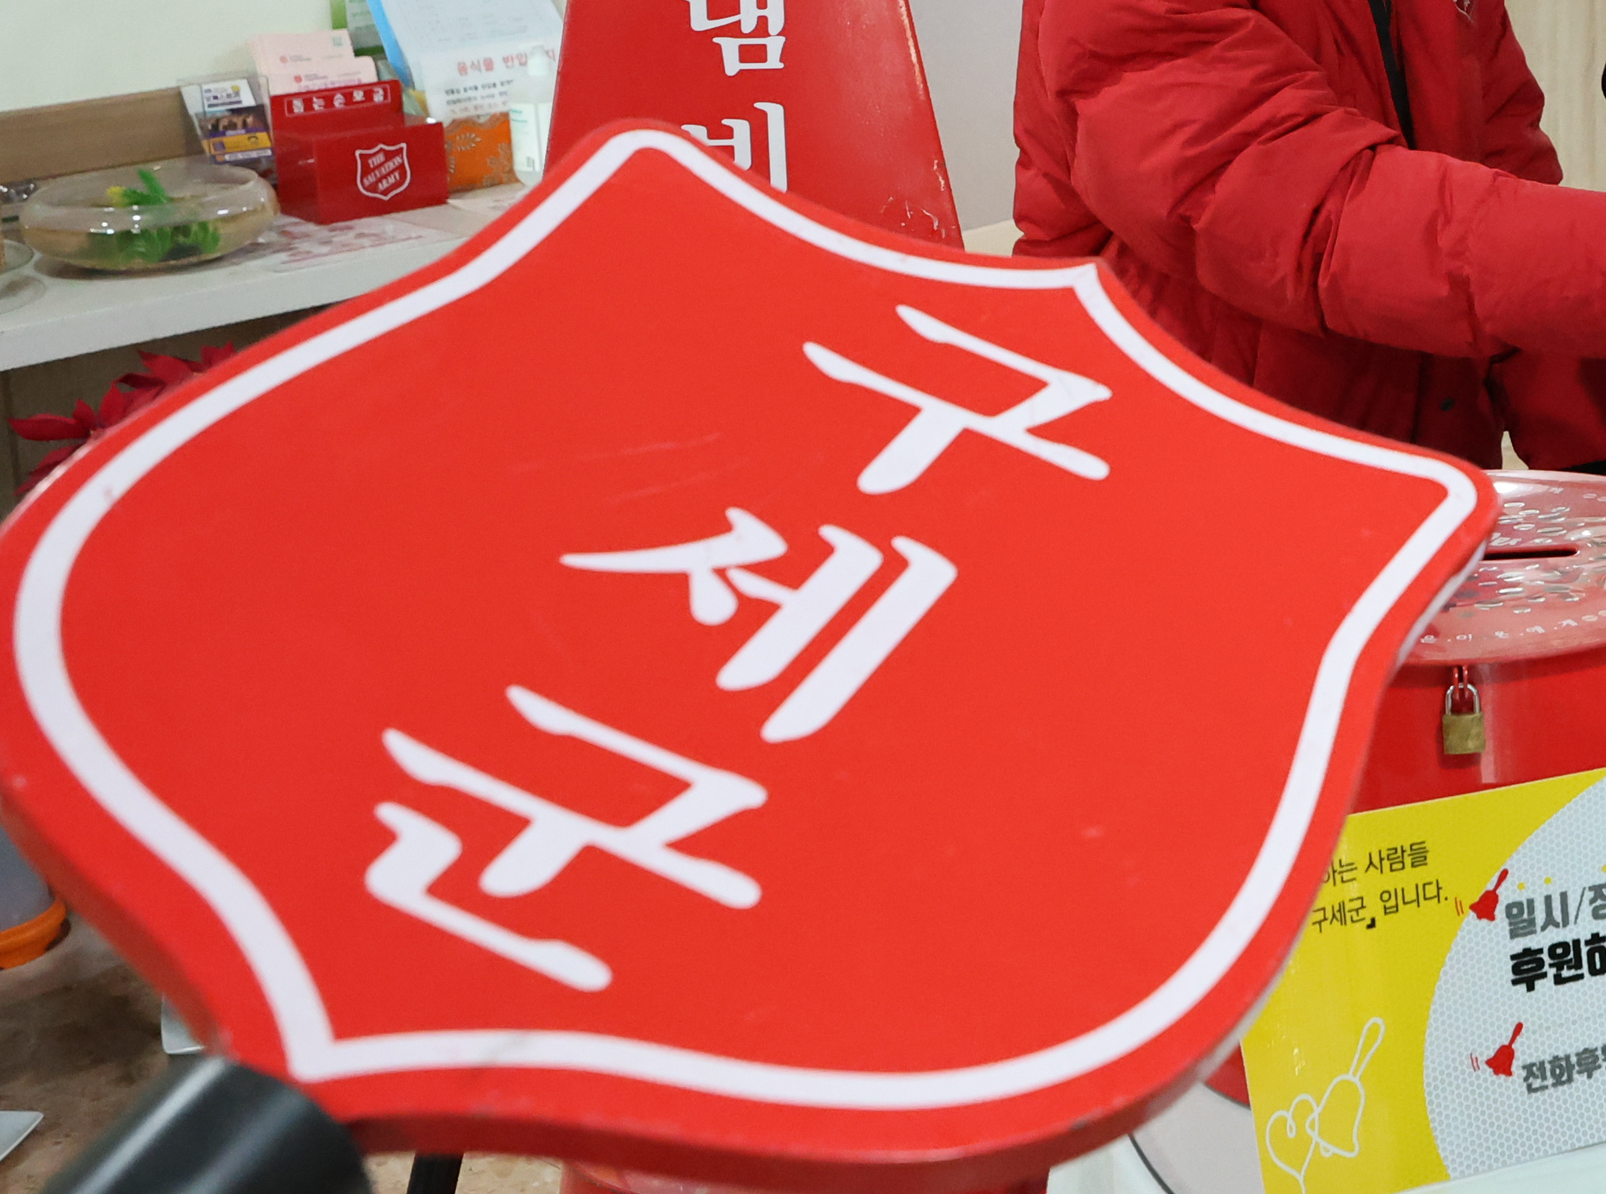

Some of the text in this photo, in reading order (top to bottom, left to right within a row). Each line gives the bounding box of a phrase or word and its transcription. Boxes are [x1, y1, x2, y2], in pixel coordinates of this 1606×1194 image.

[365, 304, 1112, 992] 구세군
[1364, 840, 1430, 875] 사람들
[1379, 878, 1449, 916] 입니다.
